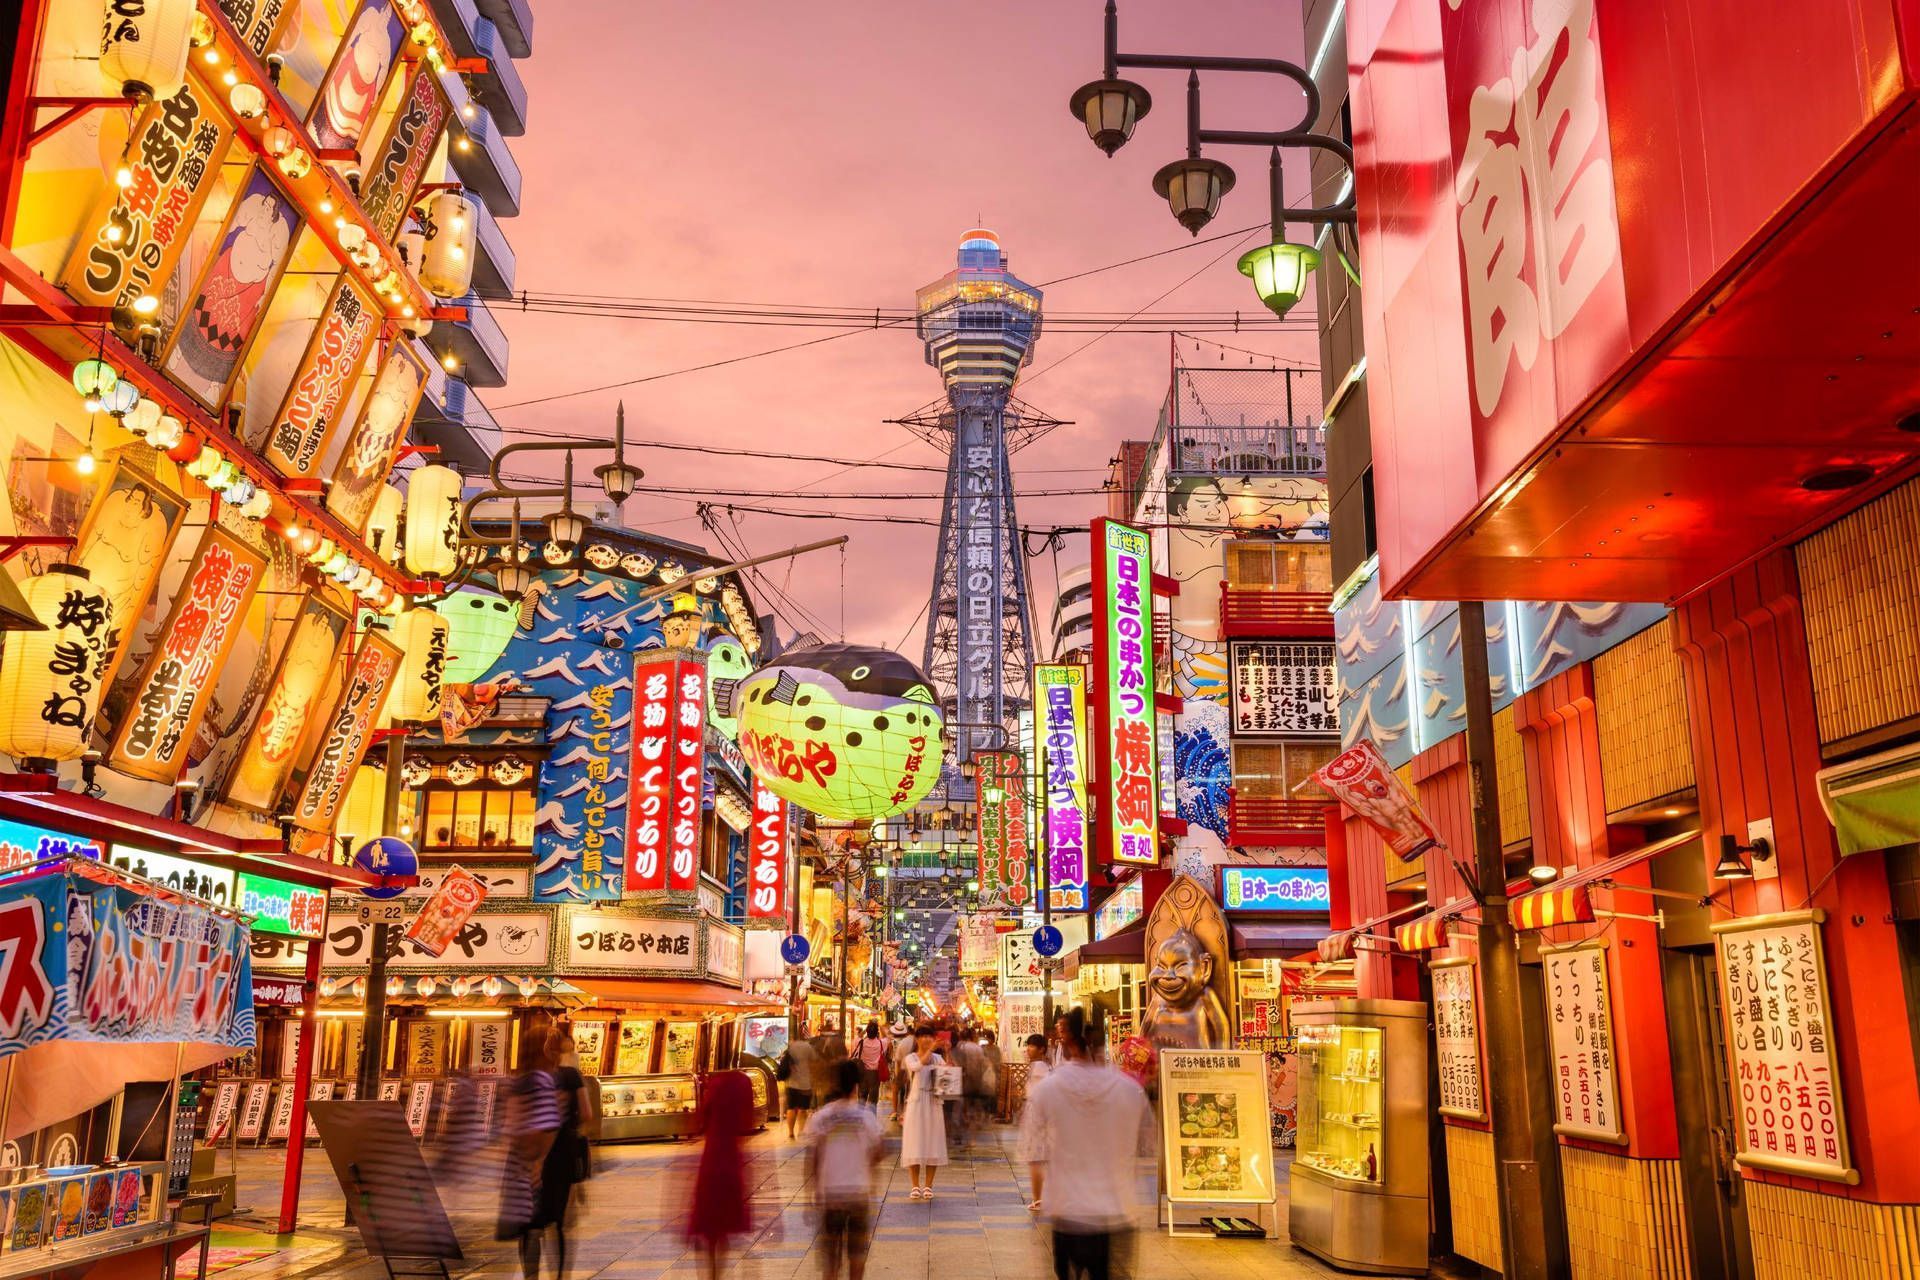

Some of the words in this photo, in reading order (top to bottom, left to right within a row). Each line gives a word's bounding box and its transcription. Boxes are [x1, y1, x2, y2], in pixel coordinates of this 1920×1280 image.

[85, 85, 200, 294] 名物串かつ
[383, 104, 443, 238] 大阪下町の味
[272, 316, 348, 463] ちゃんこ鍋
[1109, 526, 1147, 557] 新世界
[965, 446, 994, 750] 安心と信頼の日立グループ
[1117, 554, 1145, 715] 日本一の串かつ
[126, 542, 233, 758] 横綱巻き
[156, 563, 252, 763] 盛り沢山具材
[301, 645, 383, 818] 揚げたこ焼き
[643, 673, 668, 729] 名物
[679, 673, 701, 728] 名物
[1047, 688, 1076, 803] 日本一の串かつ
[1239, 687, 1252, 730] もち
[1267, 687, 1282, 730] 紅しょうが
[1280, 687, 1295, 730] にんにく
[1294, 687, 1309, 730] 玉ねぎ
[1308, 687, 1323, 730] 山芋
[1323, 687, 1337, 730] しし唐
[891, 735, 927, 807] づぼらや
[1114, 717, 1153, 831] 横綱
[635, 765, 664, 880] てっちり
[673, 765, 698, 880] てっちり
[754, 776, 781, 912] 味てっちり
[1041, 807, 1085, 888] 横綱
[1121, 833, 1152, 858] 酒処
[288, 890, 325, 932] 横綱
[1242, 879, 1328, 899] 日本一の串かつ
[328, 922, 489, 960] づぼや
[577, 930, 690, 956] づぼらや本店
[1551, 960, 1565, 1023] てっさ
[1569, 958, 1585, 1046] てっちり
[1726, 942, 1748, 1051] にぎりずし
[1742, 939, 1768, 1051] すし盛合
[1762, 938, 1785, 1051] 上にぎり
[1778, 936, 1803, 1051] ふぐにぎり
[1796, 934, 1825, 1054] ふぐにぎり盛合
